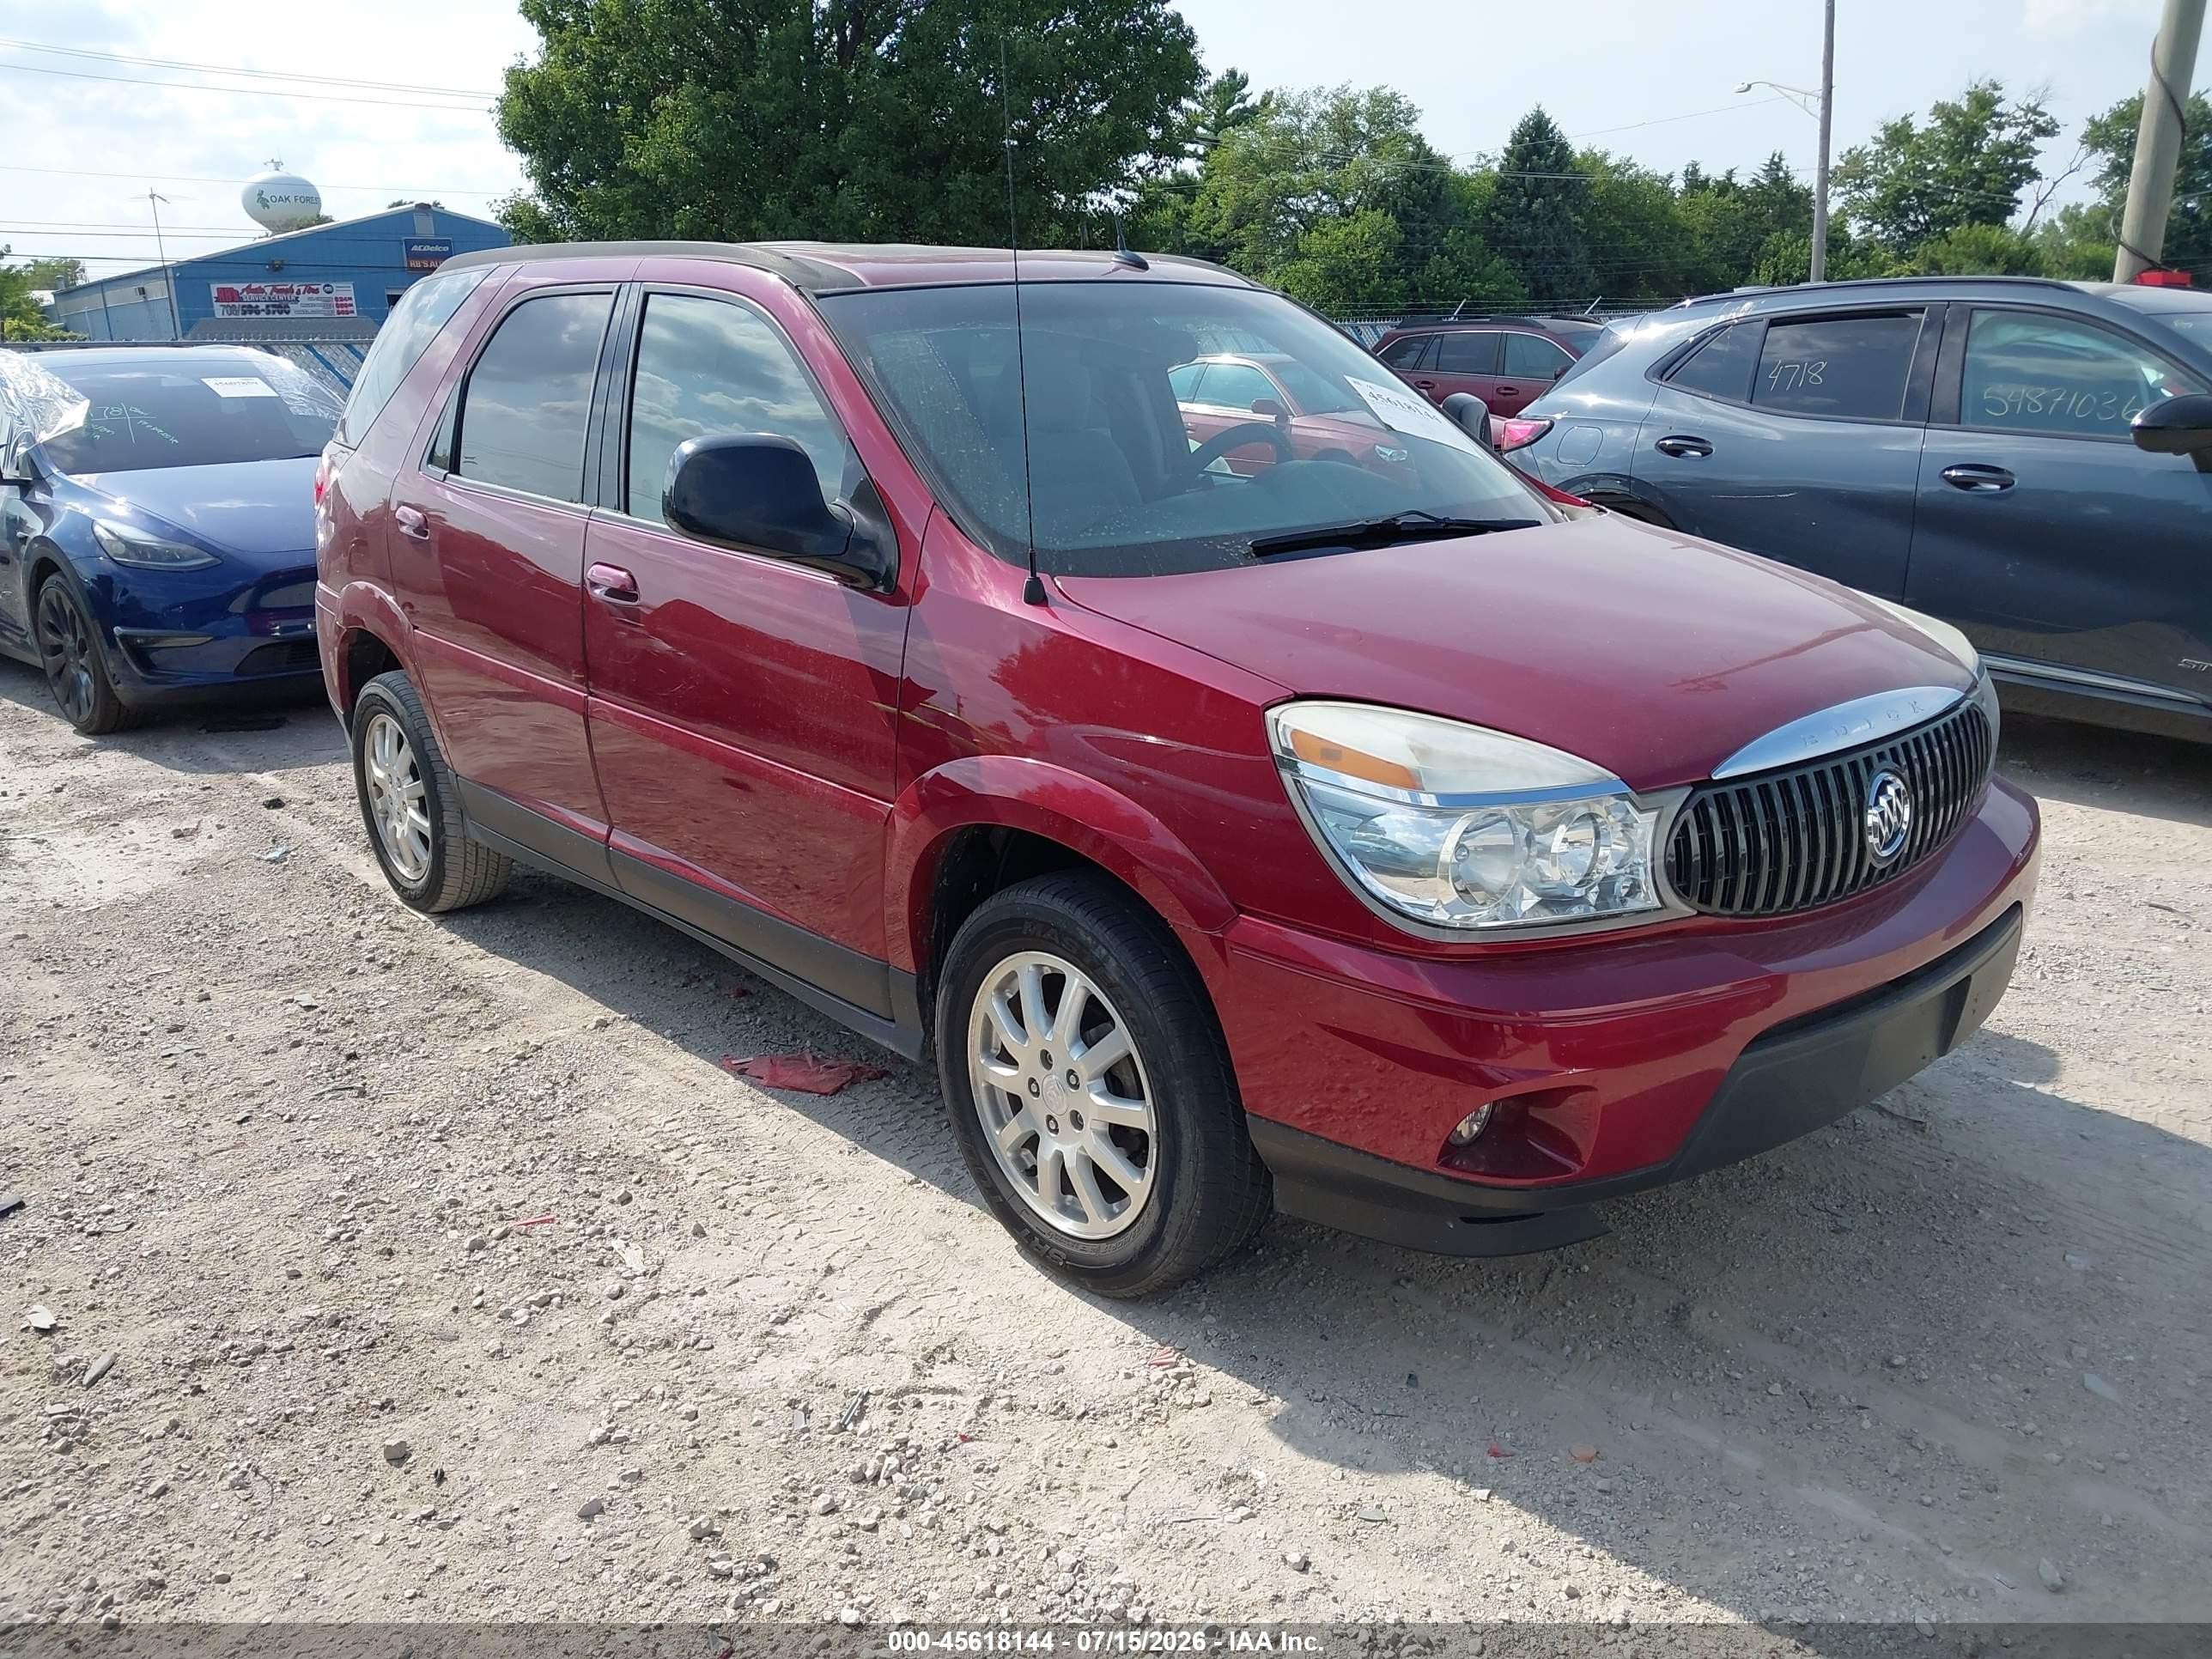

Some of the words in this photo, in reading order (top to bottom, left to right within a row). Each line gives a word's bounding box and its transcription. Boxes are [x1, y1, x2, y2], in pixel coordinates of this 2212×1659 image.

[270, 194, 290, 204] OAK
[1769, 359, 1828, 391] 4718
[1984, 386, 2142, 420] 54871036
